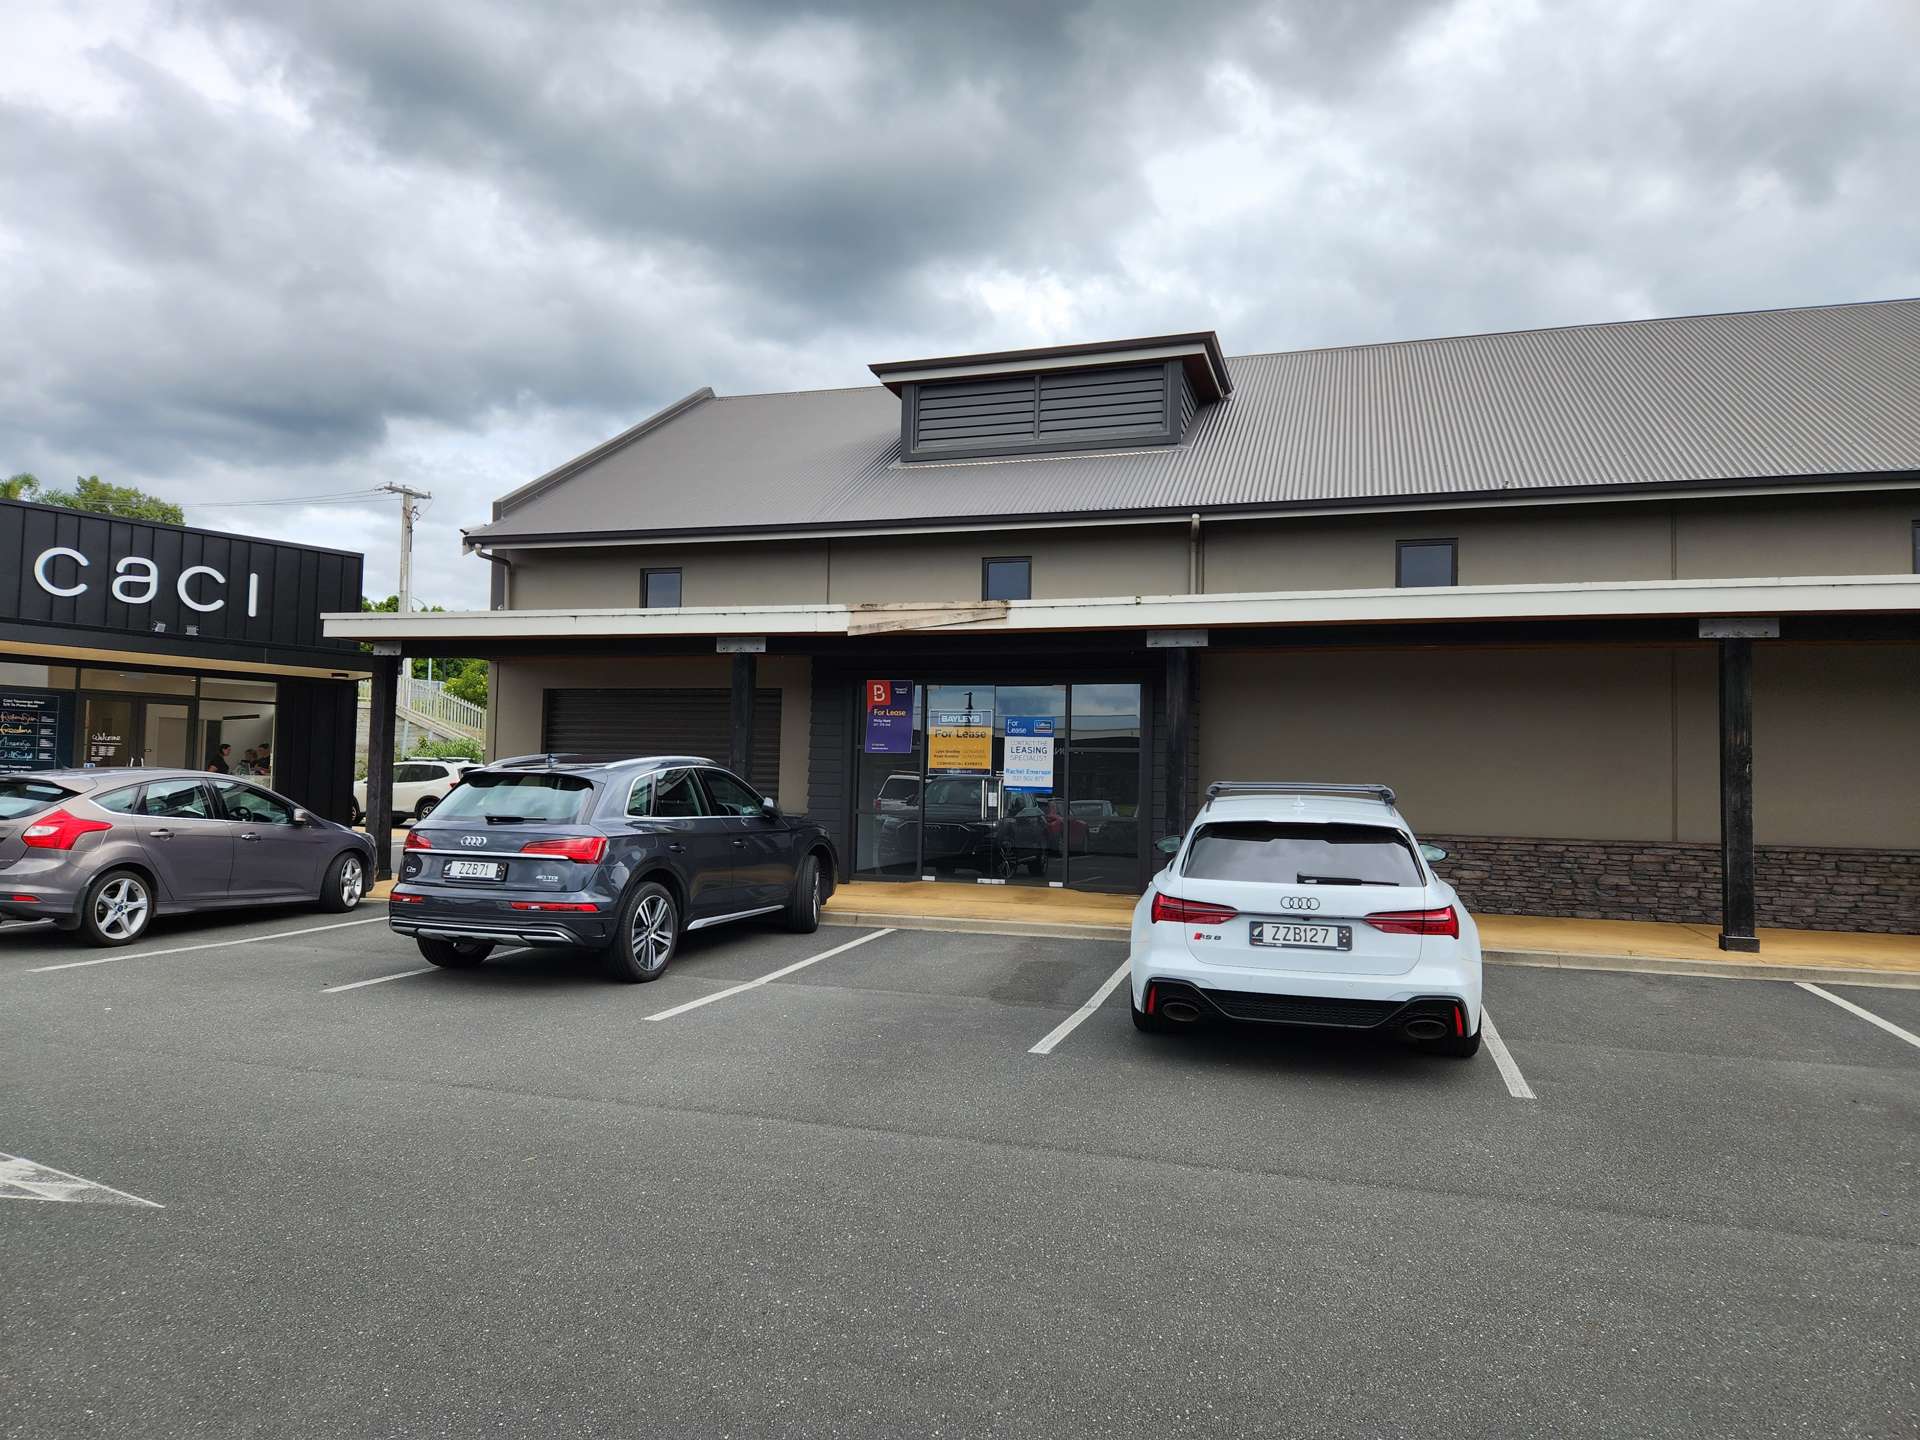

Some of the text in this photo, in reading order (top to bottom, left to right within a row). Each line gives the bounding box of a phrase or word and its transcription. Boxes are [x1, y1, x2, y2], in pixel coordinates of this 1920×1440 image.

[873, 684, 886, 701] B
[886, 709, 906, 717] Lease
[941, 715, 980, 723] BAYLEYS
[1007, 719, 1018, 727] For
[935, 729, 986, 738] For Lease
[1010, 746, 1048, 755] LEASING
[458, 863, 489, 876] ZZB71
[1271, 925, 1330, 944] ZZB127
